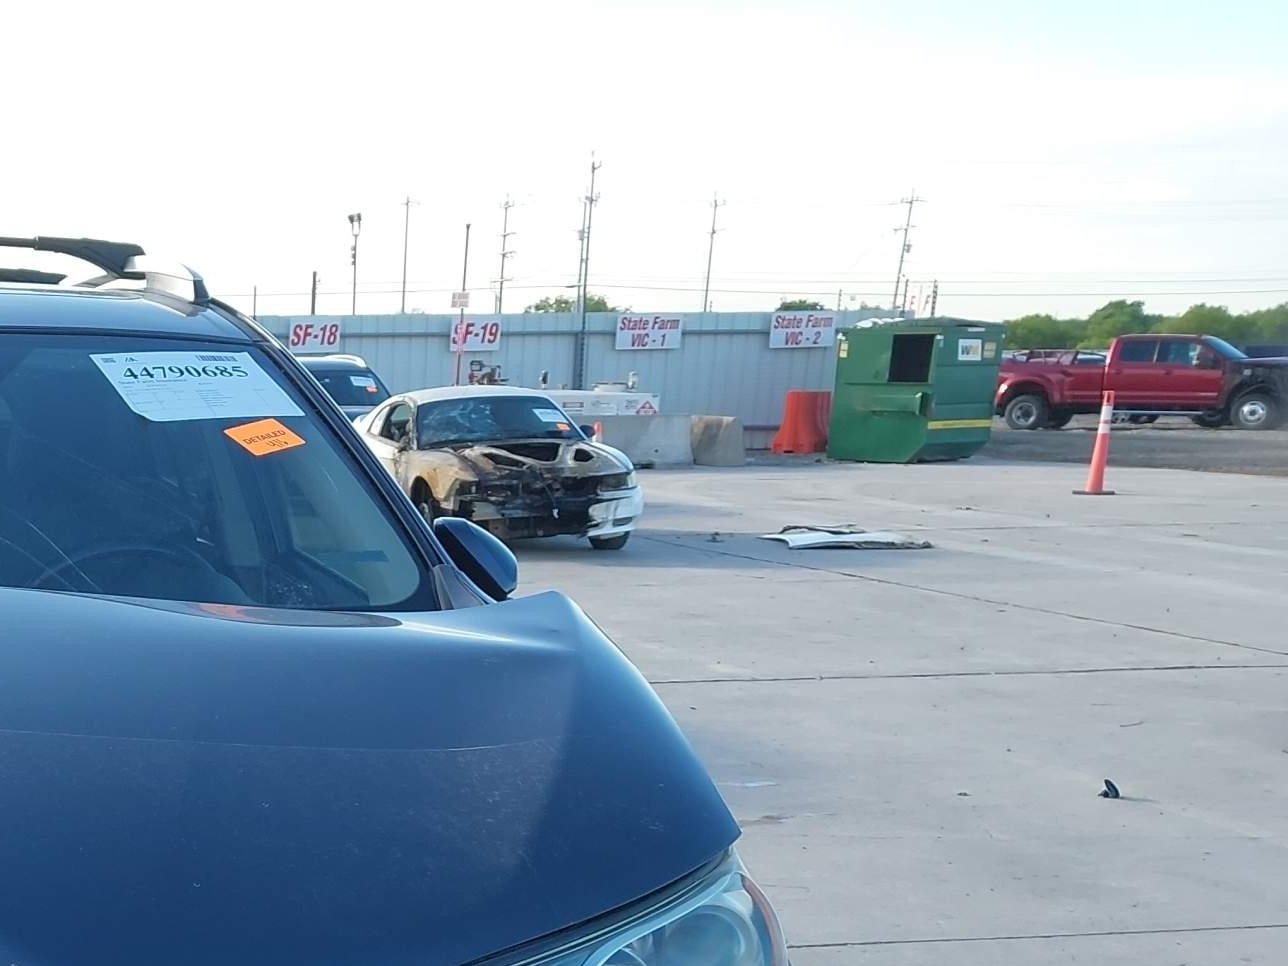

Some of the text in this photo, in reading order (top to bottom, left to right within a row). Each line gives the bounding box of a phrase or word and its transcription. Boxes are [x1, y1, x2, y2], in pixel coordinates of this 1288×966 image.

[619, 315, 680, 331] State Farm
[773, 313, 833, 329] State Farm
[290, 323, 339, 347] SF-18
[631, 333, 649, 347] VIC
[660, 333, 667, 347] 1
[784, 331, 802, 346] VIC
[812, 331, 822, 345] 2
[123, 365, 249, 380] 44790685
[242, 429, 287, 445] DETAILED
